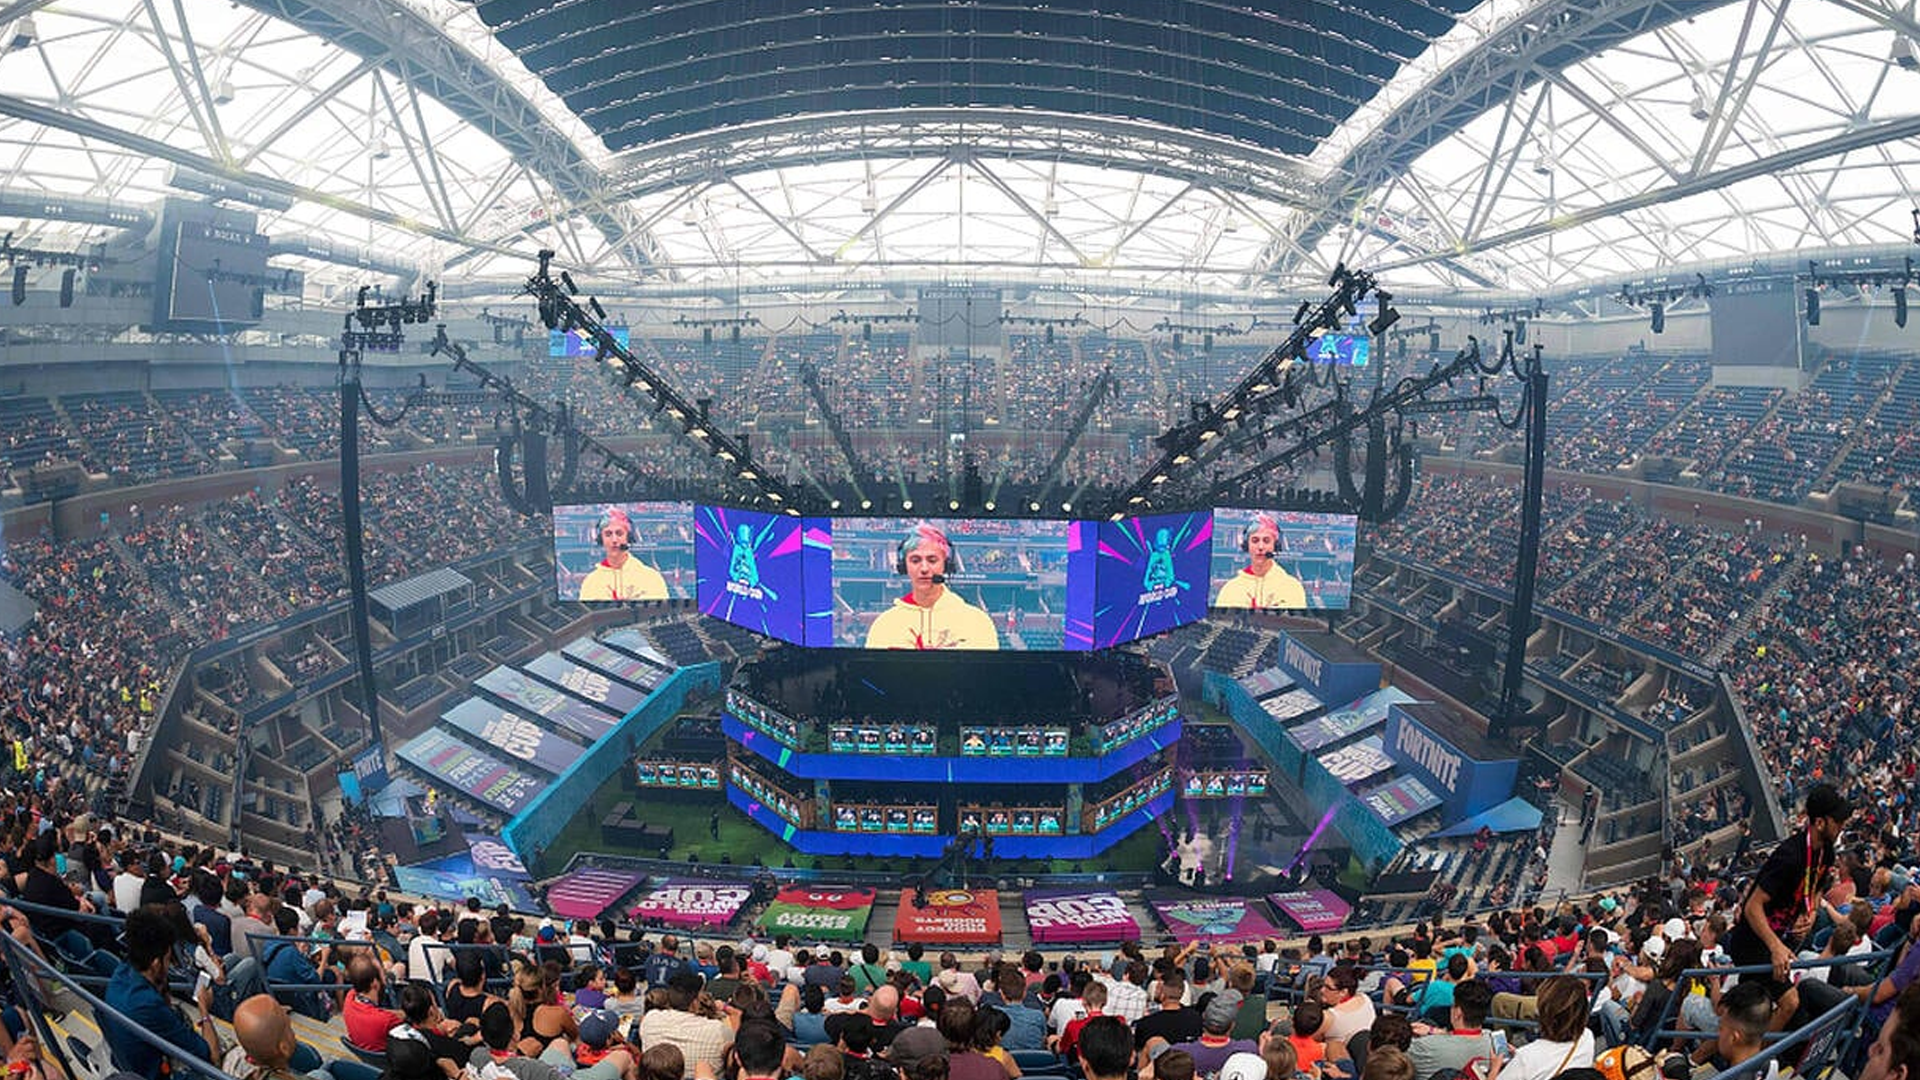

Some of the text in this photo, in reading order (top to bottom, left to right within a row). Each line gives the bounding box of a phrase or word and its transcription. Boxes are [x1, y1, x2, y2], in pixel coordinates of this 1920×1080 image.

[1396, 717, 1462, 794] FORTNITE
[649, 889, 751, 902] CUP
[637, 900, 741, 910] WORLD
[1026, 896, 1127, 917] CUP
